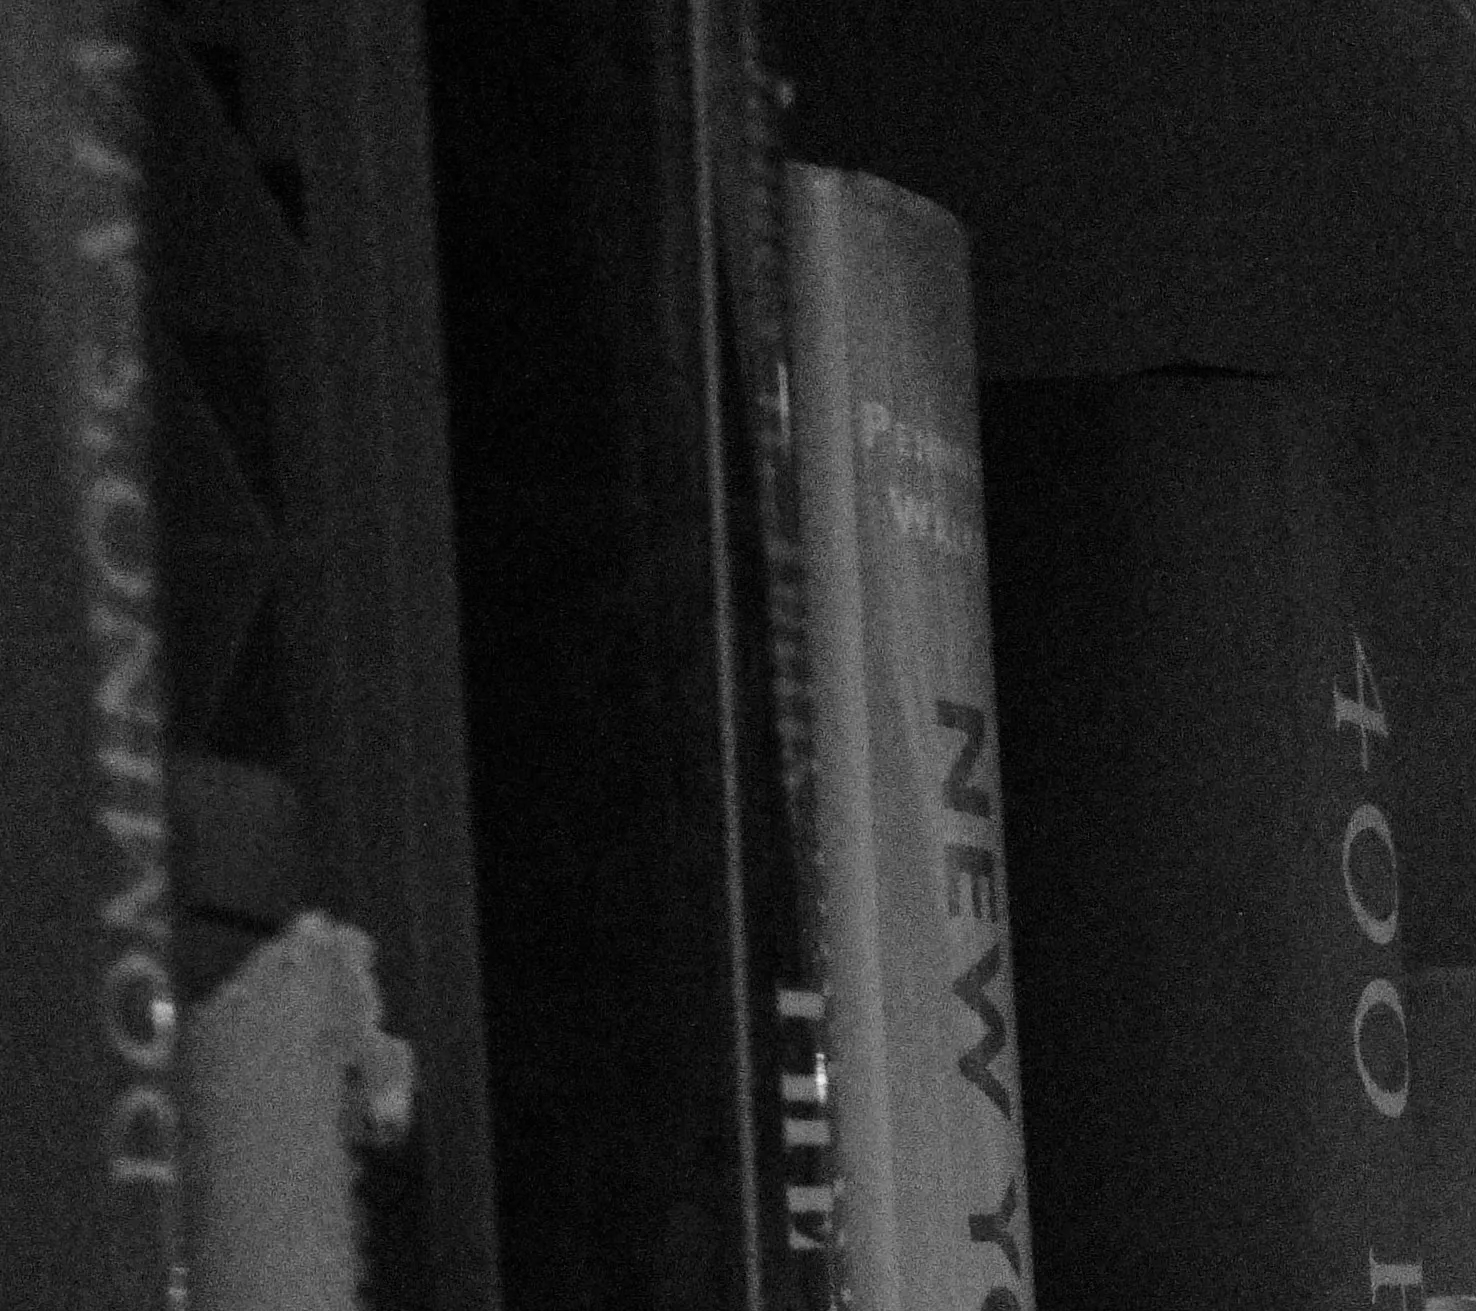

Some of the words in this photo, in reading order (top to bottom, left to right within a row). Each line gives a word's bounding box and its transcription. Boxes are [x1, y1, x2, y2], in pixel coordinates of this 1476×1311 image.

[933, 695, 1010, 1125] NEW
[1329, 630, 1411, 1118] 400
[777, 988, 838, 1248] THE
